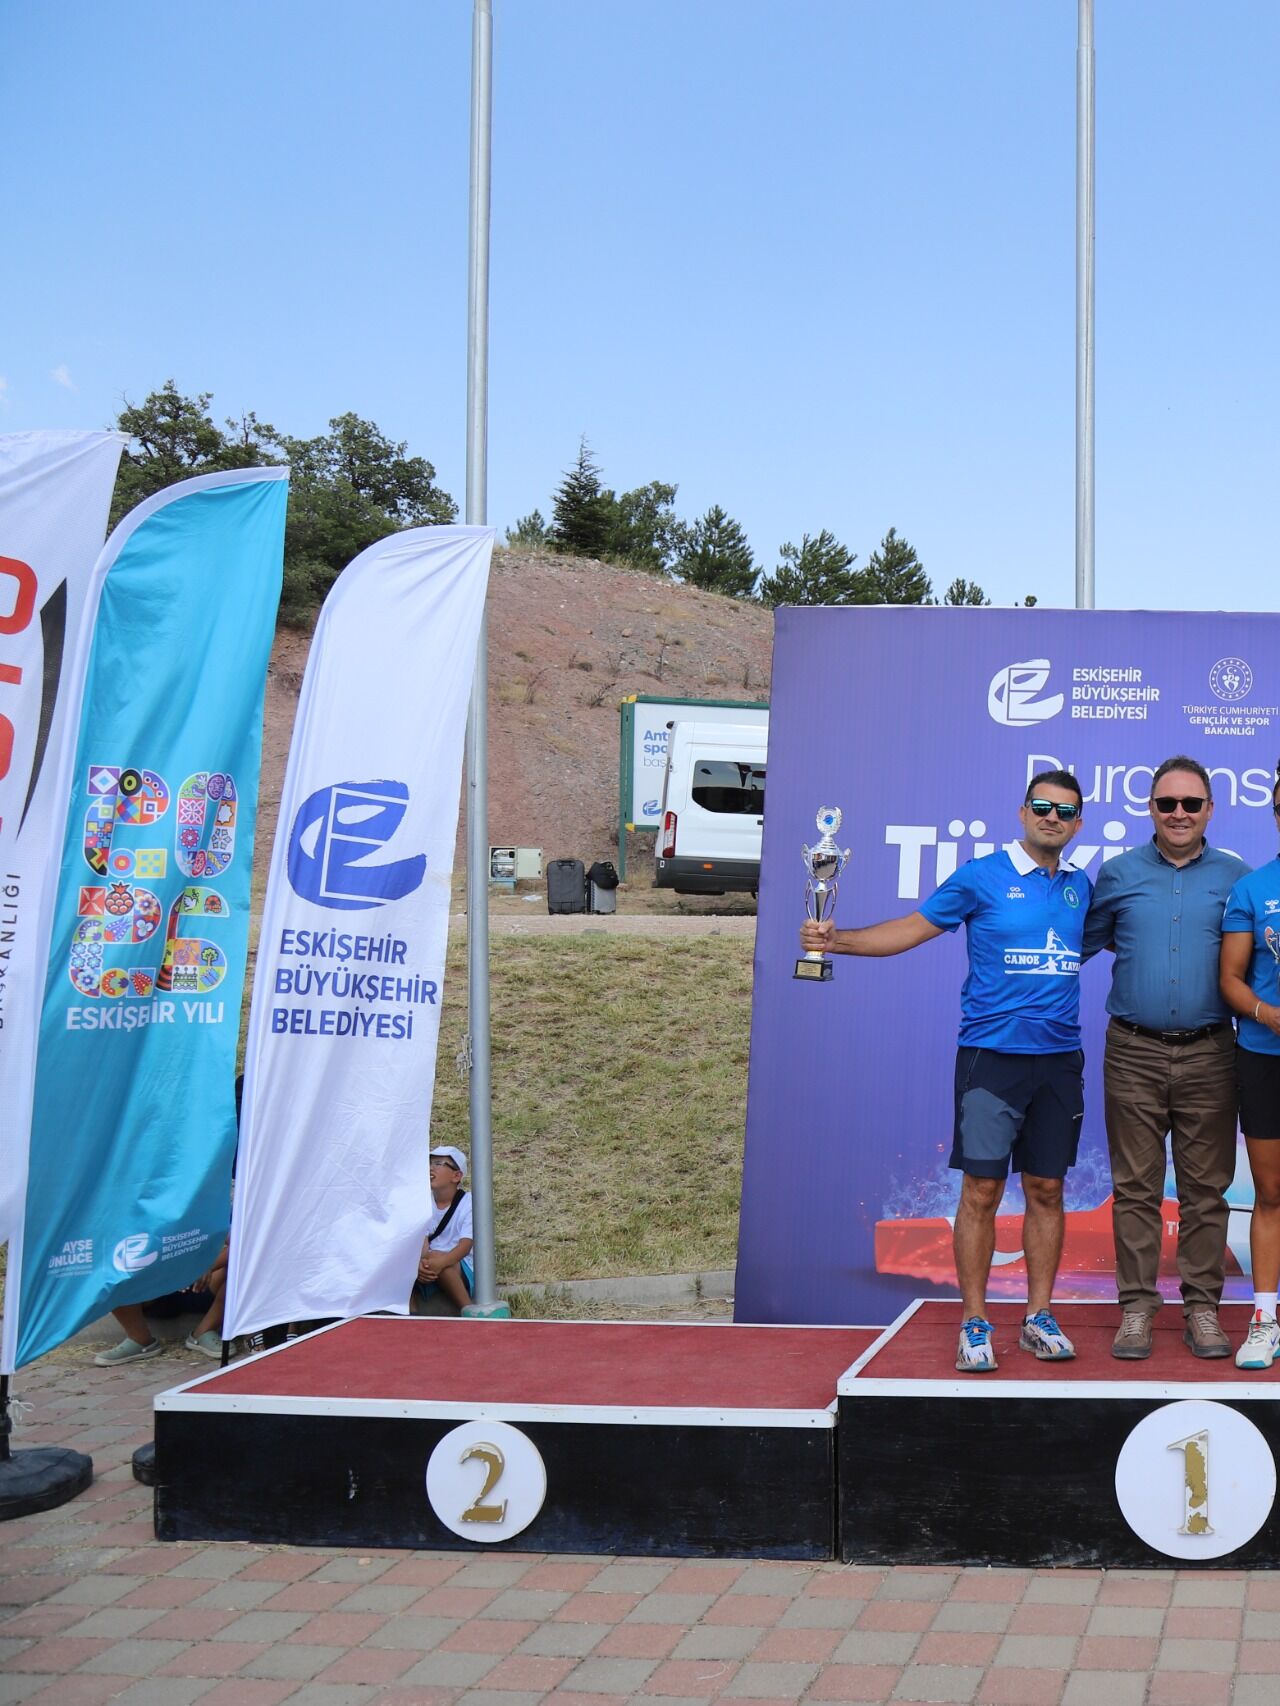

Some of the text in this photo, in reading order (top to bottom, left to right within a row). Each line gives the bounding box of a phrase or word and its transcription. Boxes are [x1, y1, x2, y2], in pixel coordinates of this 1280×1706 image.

[1073, 666, 1142, 684] ESKİŞEHİR
[1072, 685, 1160, 703] BÜYÜKŞEHİR
[1071, 703, 1147, 720] BELEDİYESİ
[1182, 705, 1279, 716] TÜRKİYE CUMHURİYETİ
[1189, 715, 1270, 726] GENÇLİK VE SPOR
[1204, 726, 1255, 735] BAKANLIĞI
[280, 928, 408, 965] ESKİŞEHİR
[1004, 954, 1040, 965] CANOE
[275, 964, 438, 1005] BÜYÜKŞEHİR
[183, 1001, 225, 1024] YILI
[271, 1006, 413, 1040] BELEDİYESİ
[458, 1441, 509, 1525] 2
[1167, 1428, 1215, 1536] 1
